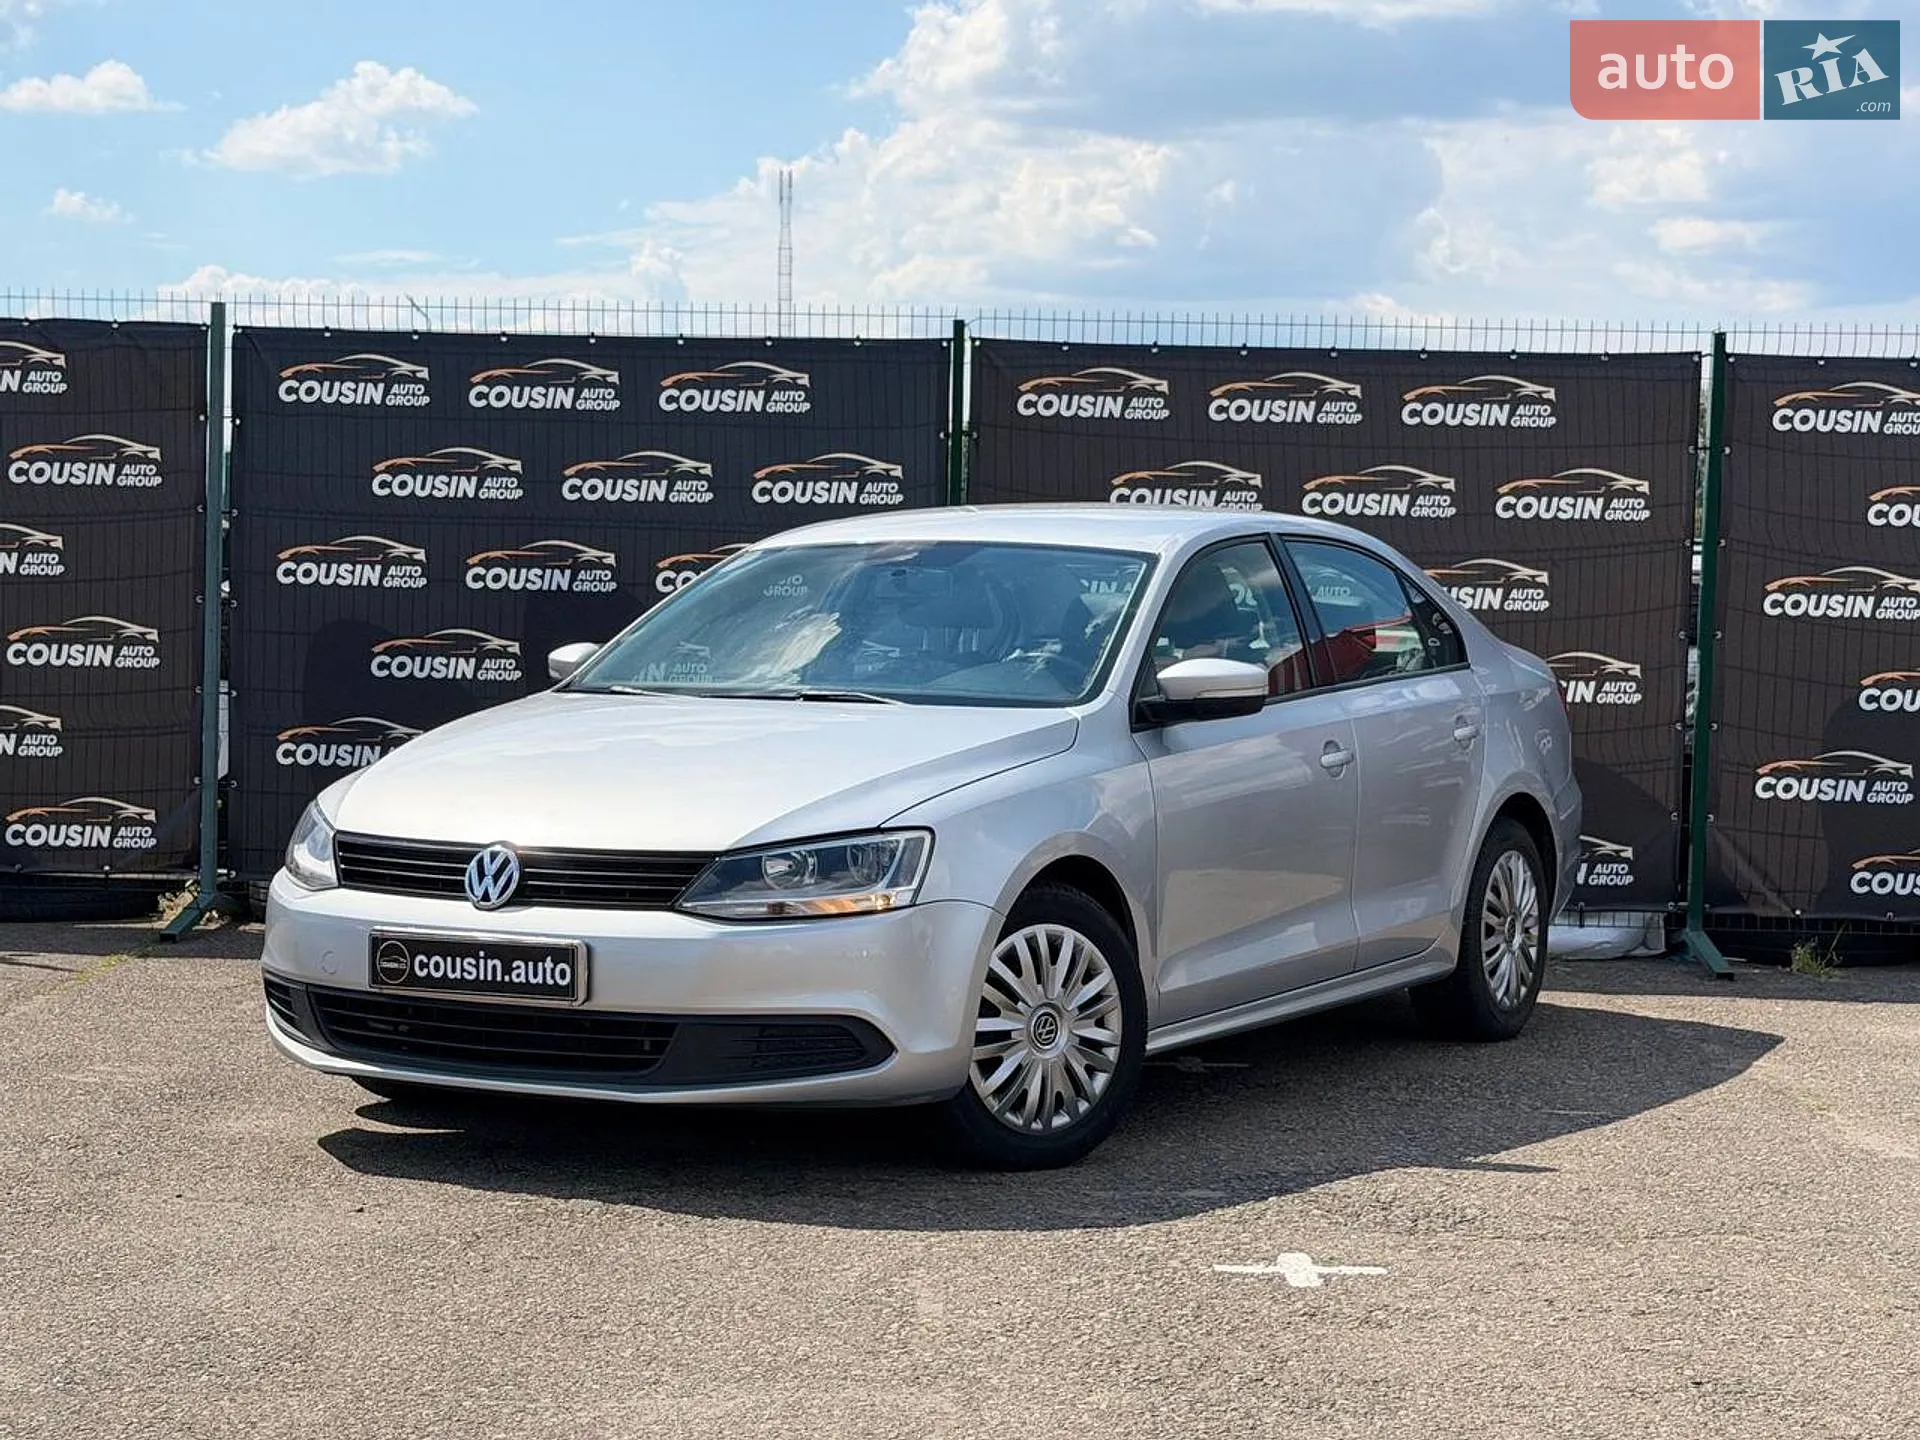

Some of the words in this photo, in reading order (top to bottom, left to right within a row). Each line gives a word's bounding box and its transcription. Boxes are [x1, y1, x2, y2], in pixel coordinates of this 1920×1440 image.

[27, 370, 62, 382] AUTO
[22, 382, 68, 394] GROUP
[278, 380, 384, 404] COUSIN
[390, 384, 424, 395] AUTO
[386, 395, 430, 406] GROUP
[469, 385, 574, 409] COUSIN
[579, 389, 615, 400] AUTO
[659, 388, 765, 412] COUSIN
[770, 391, 805, 403] AUTO
[576, 400, 620, 410] GROUP
[766, 402, 810, 414] GROUP
[1017, 393, 1124, 418] COUSIN
[1129, 397, 1164, 408] AUTO
[1322, 401, 1357, 413] AUTO
[1125, 408, 1169, 420] GROUP
[1209, 398, 1315, 423] COUSIN
[1402, 402, 1508, 427] COUSIN
[1516, 404, 1550, 416] AUTO
[1317, 413, 1362, 424] GROUP
[1511, 415, 1556, 428] GROUP
[1772, 408, 1882, 433] COUSIN
[1883, 423, 1920, 435] GROU
[8, 461, 115, 485] COUSIN
[122, 464, 156, 475] AUTO
[117, 476, 162, 487] GROUP
[372, 474, 477, 498] COUSIN
[483, 477, 518, 489] AUTO
[674, 481, 708, 492] AUTO
[479, 489, 523, 499] GROUP
[562, 478, 668, 501] COUSIN
[752, 481, 858, 503] COUSIN
[864, 483, 898, 494] AUTO
[669, 491, 713, 504] GROUP
[860, 494, 904, 506] GROUP
[1110, 488, 1217, 507] COUSIN
[1222, 491, 1257, 502] AUTO
[1415, 495, 1451, 506] AUTO
[1302, 492, 1408, 517] COUSIN
[1496, 496, 1604, 521] COUSIN
[1610, 498, 1644, 510] AUTO
[1410, 506, 1456, 518] GROUP
[1605, 509, 1650, 522] GROUP
[24, 553, 59, 564] AUTO
[20, 564, 65, 576] GROUP
[277, 561, 381, 586] COUSIN
[387, 566, 421, 577] AUTO
[577, 570, 611, 582] AUTO
[383, 577, 427, 588] GROUP
[466, 567, 571, 590] COUSIN
[573, 582, 617, 592] GROUP
[1509, 588, 1545, 600] AUTO
[1504, 600, 1550, 611] GROUP
[1763, 592, 1874, 618] COUSIN
[1881, 597, 1917, 608] AUTO
[7, 643, 112, 666] COUSIN
[120, 646, 154, 657] AUTO
[115, 656, 160, 669] GROUP
[371, 656, 476, 679] COUSIN
[482, 659, 515, 670] AUTO
[477, 670, 521, 680] GROUP
[1602, 682, 1636, 693] AUTO
[1596, 693, 1642, 704] GROUP
[1858, 688, 1920, 712] COU
[22, 734, 57, 745] AUTO
[18, 745, 63, 757] GROUP
[276, 742, 380, 767] COUSIN
[1755, 776, 1866, 802] COUSIN
[1872, 781, 1908, 792] AUTO
[1867, 792, 1913, 804] GROUP
[6, 824, 111, 847] COUSIN
[117, 827, 151, 838] AUTO
[113, 837, 156, 850] GROUP
[1593, 864, 1628, 874] AUTO
[1588, 874, 1634, 885] GROUP
[1850, 871, 1920, 895] COU
[413, 951, 572, 986] cousin.auto
